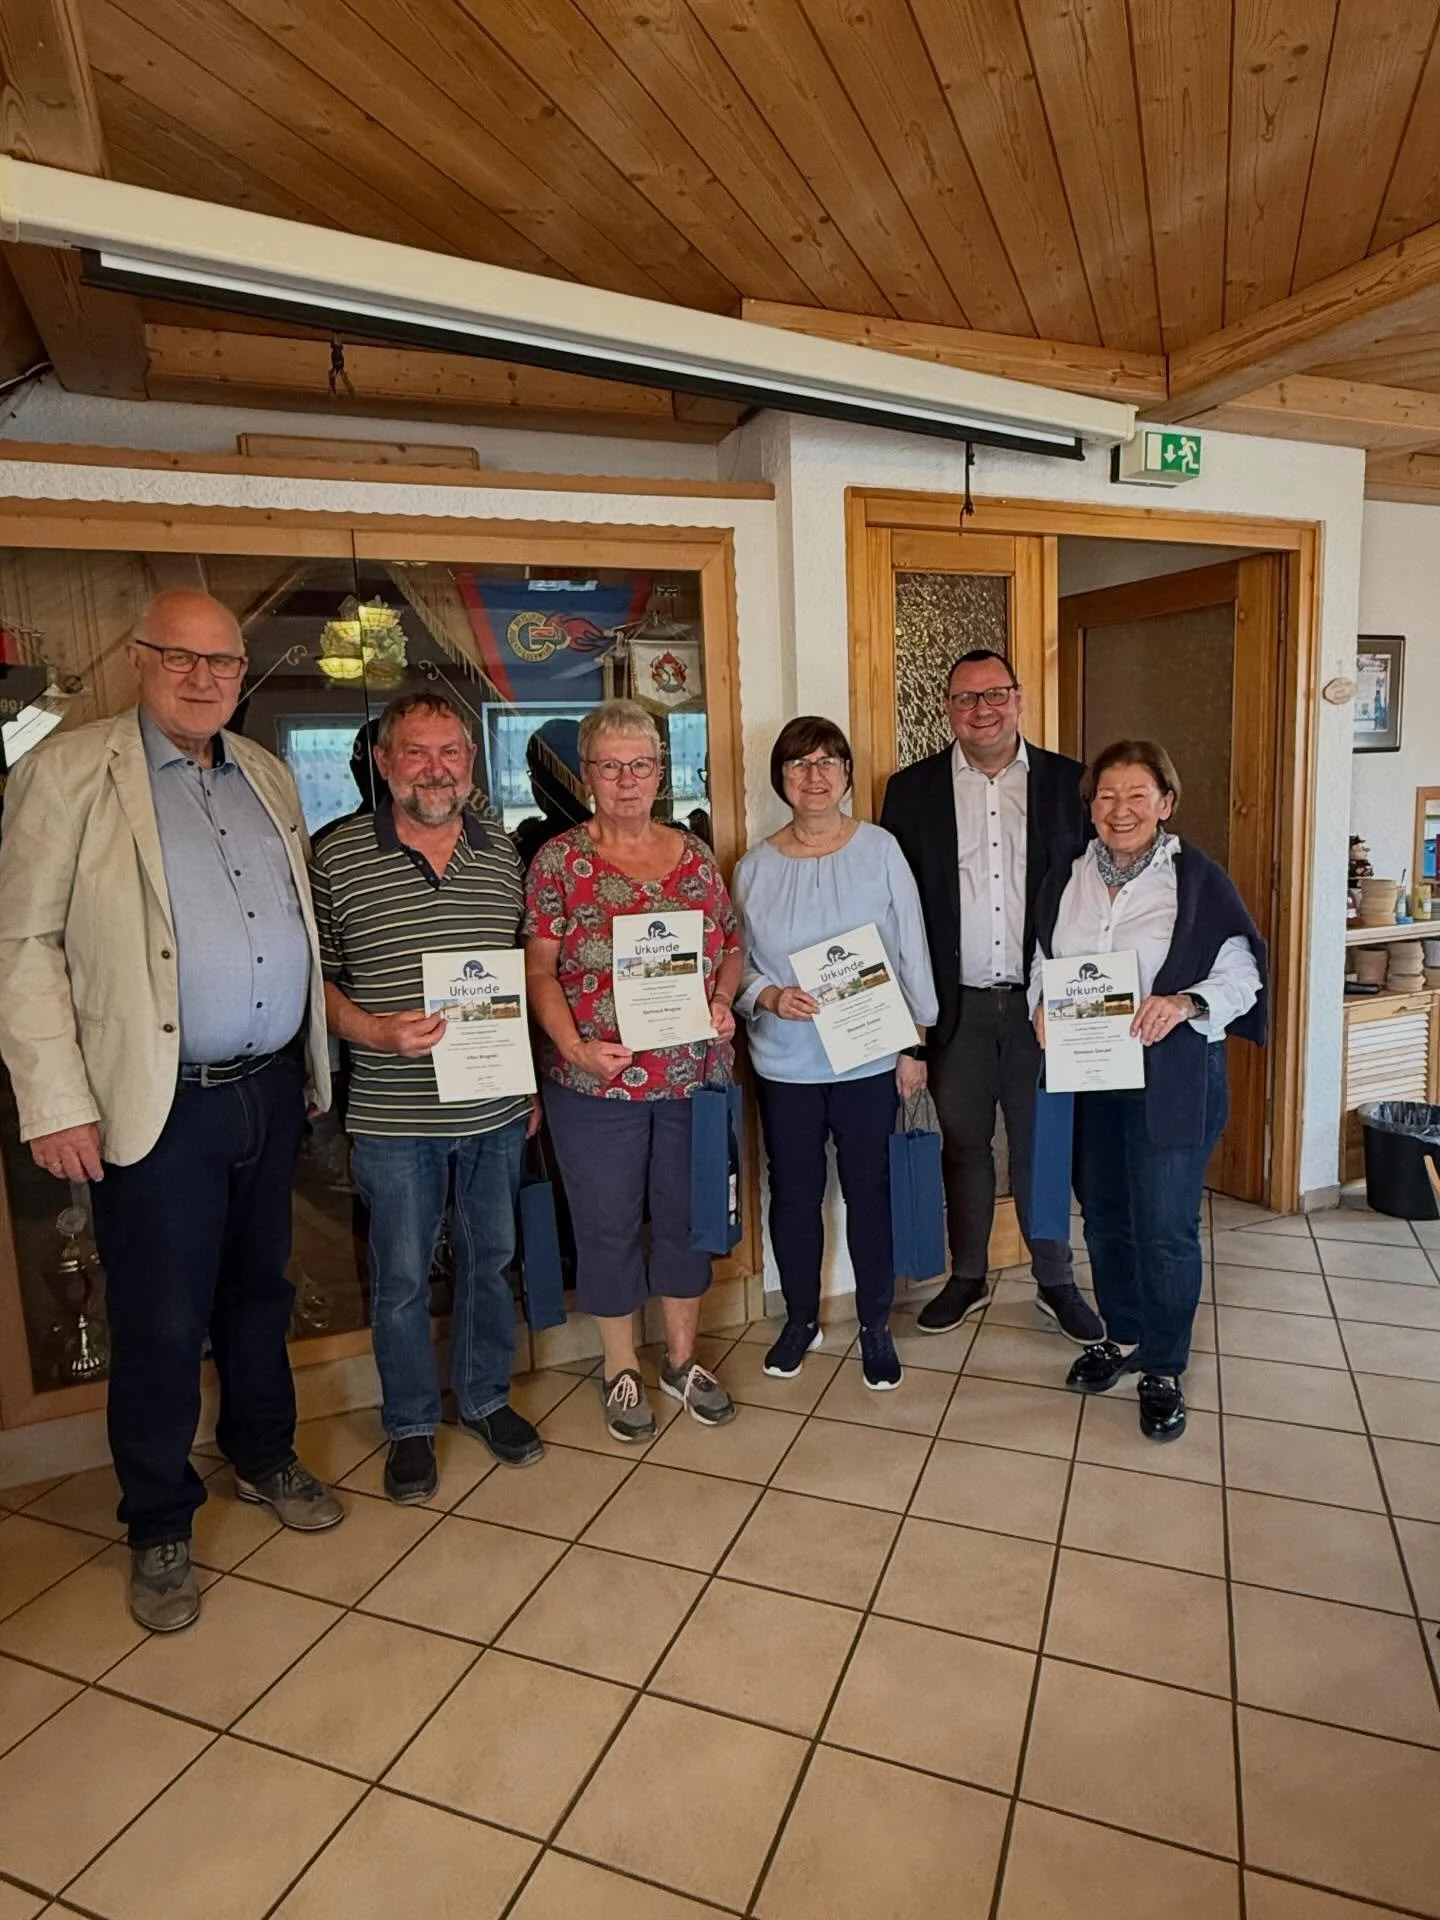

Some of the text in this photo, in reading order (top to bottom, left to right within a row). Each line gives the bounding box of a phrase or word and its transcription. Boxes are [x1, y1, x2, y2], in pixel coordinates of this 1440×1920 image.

[635, 943, 680, 955] Urkunde
[820, 959, 865, 983] Urkunde
[450, 984, 500, 997] Urkunde
[1066, 983, 1114, 997] Urkunde
